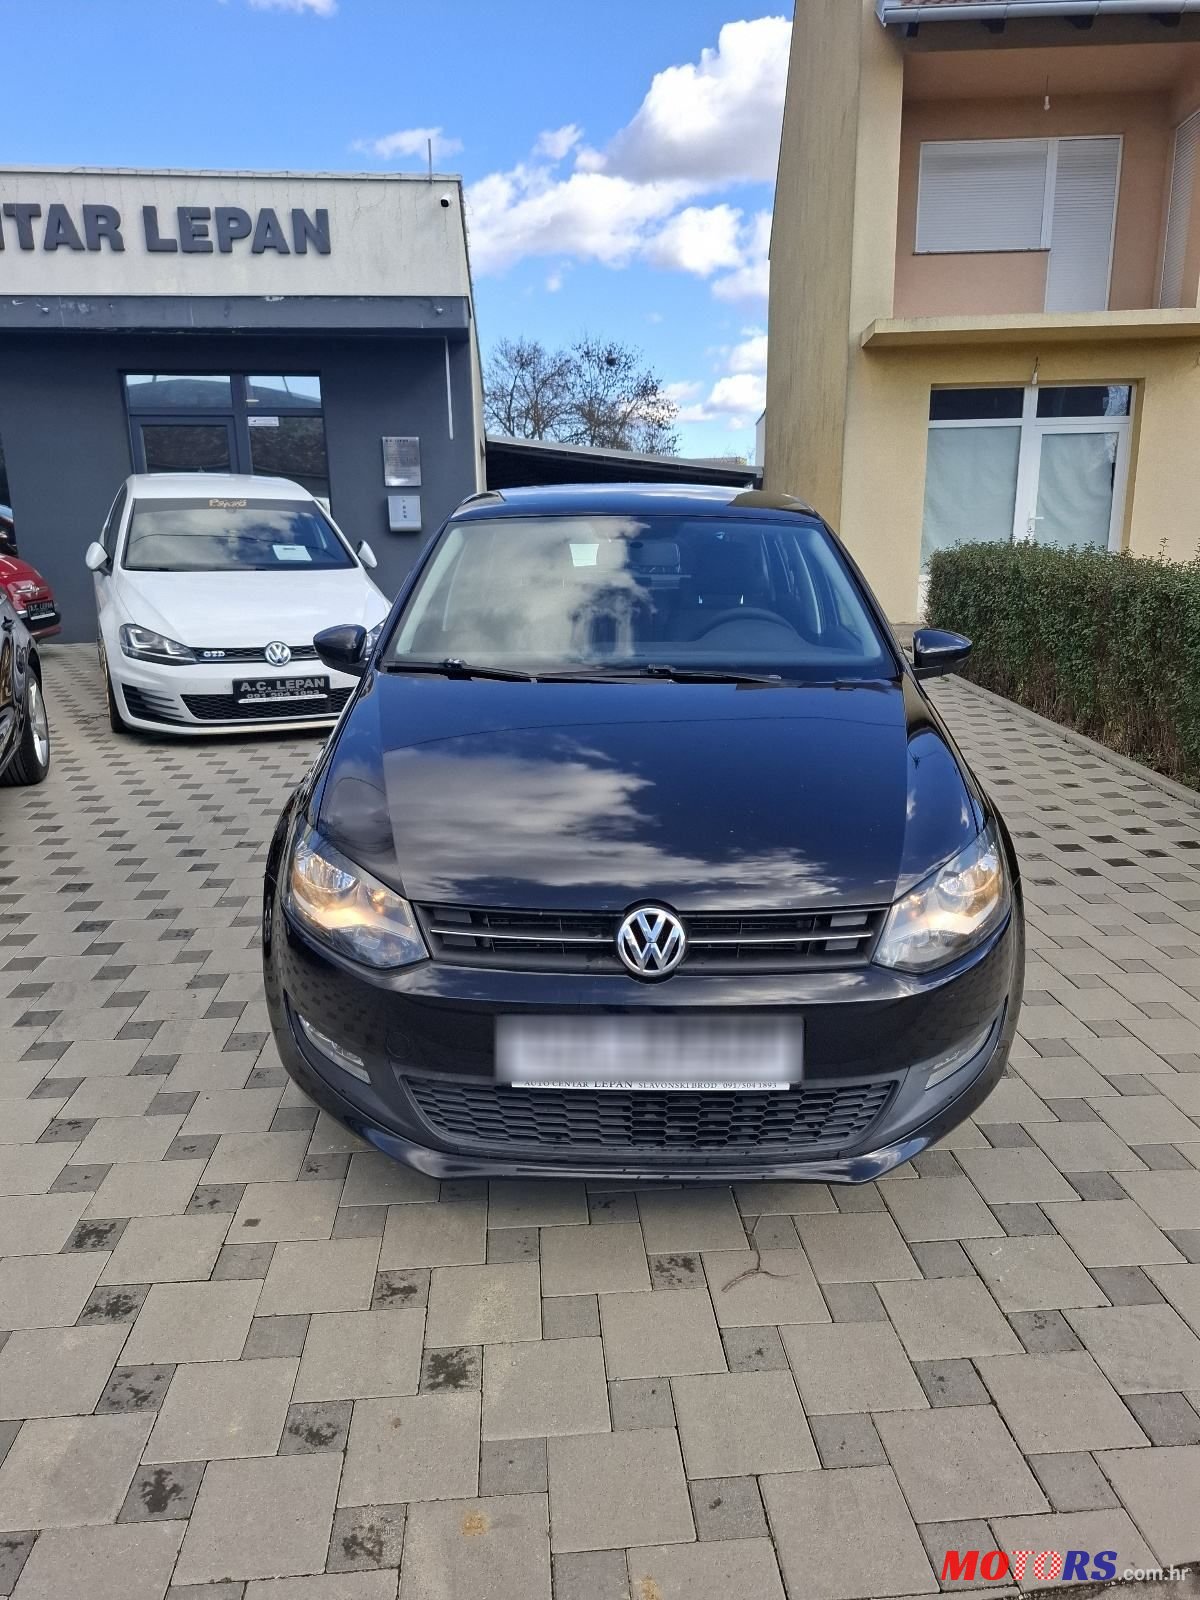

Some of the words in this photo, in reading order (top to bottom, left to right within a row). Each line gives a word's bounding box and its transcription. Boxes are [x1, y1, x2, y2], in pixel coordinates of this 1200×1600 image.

[0, 203, 125, 251] TAR
[142, 205, 331, 255] LEPAN
[203, 650, 226, 658] GTD
[240, 681, 272, 692] A.C.
[276, 678, 325, 690] LEPAN
[594, 1080, 634, 1089] LEPAN
[638, 1080, 689, 1089] SLAVONSKI
[691, 1081, 718, 1089] BROD
[758, 1081, 778, 1089] 1893
